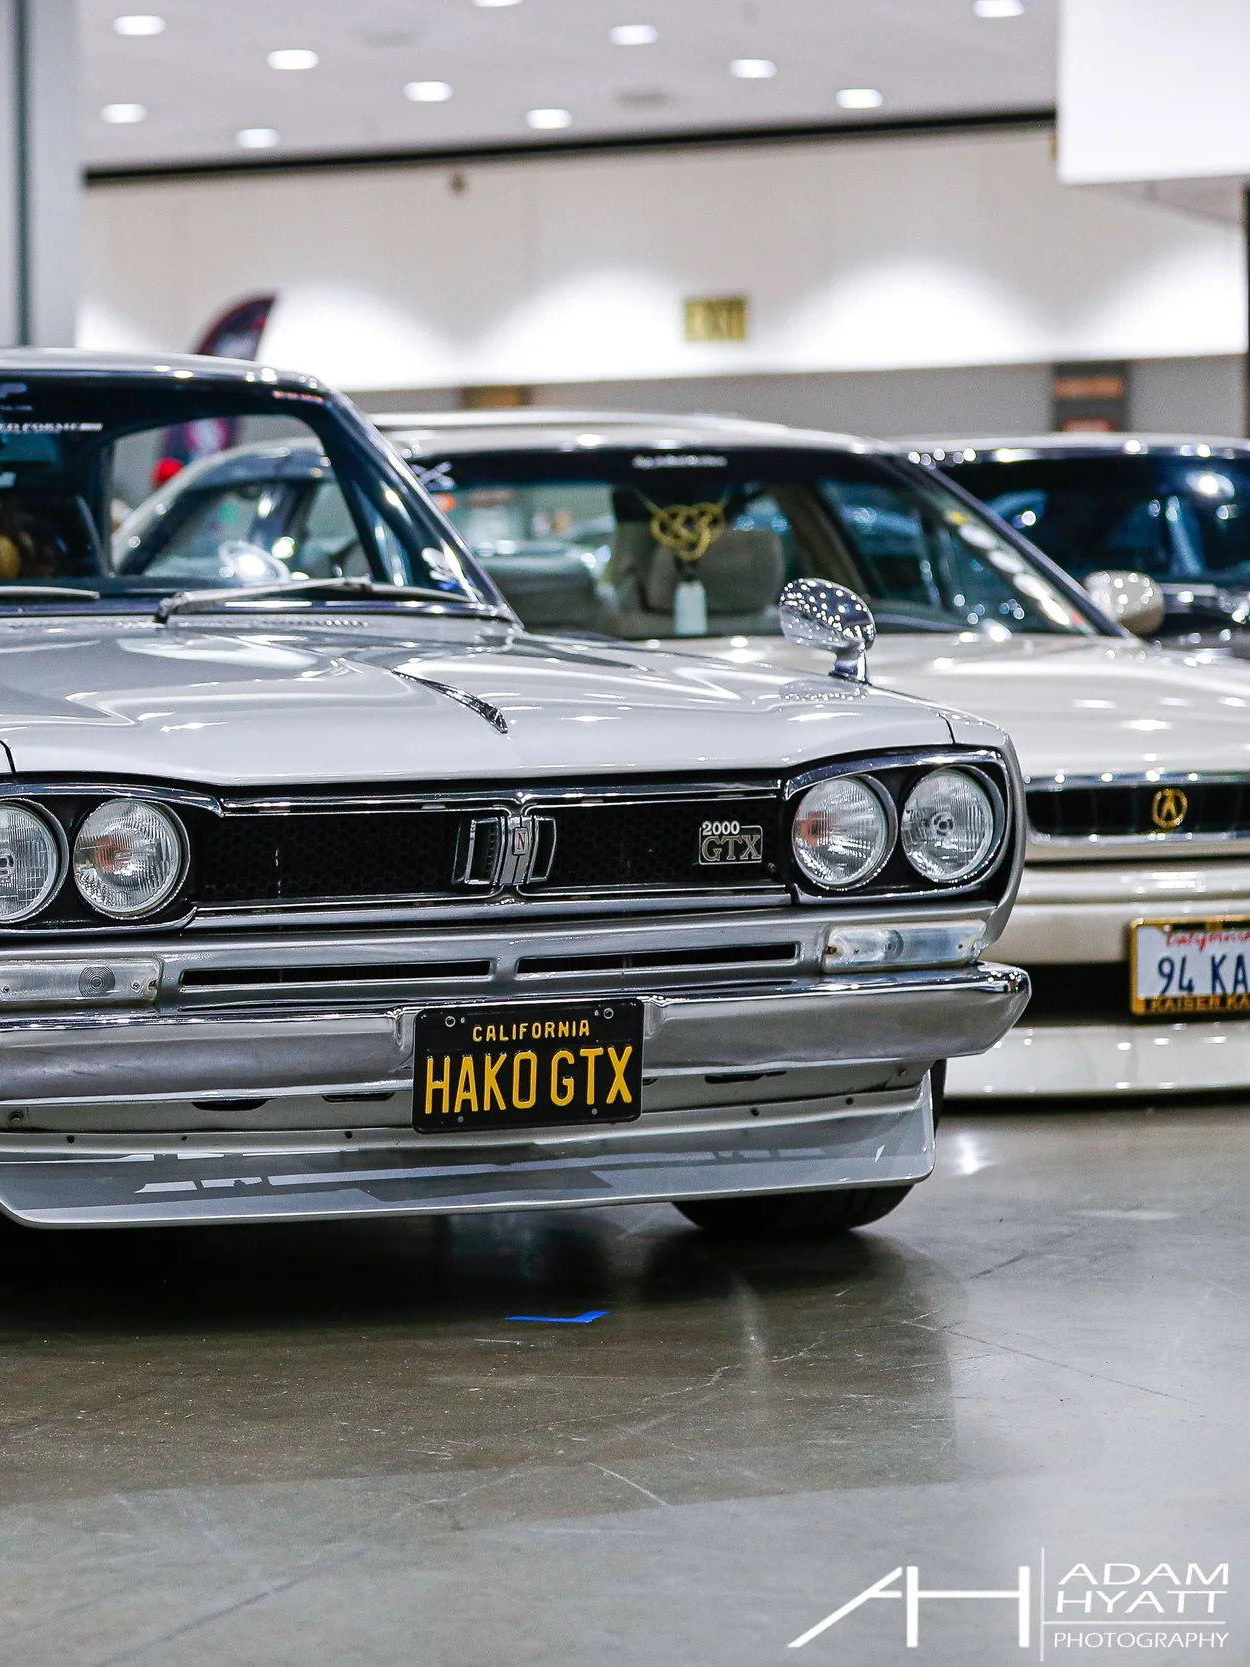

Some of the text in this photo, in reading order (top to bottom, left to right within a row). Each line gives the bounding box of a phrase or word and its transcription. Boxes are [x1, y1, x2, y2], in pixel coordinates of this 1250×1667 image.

[702, 821, 740, 835] 2000
[702, 835, 761, 861] GTX
[1158, 954, 1194, 995] 94
[473, 1020, 590, 1042] CALIFORNIA
[425, 1046, 632, 1114] HAKO GTX
